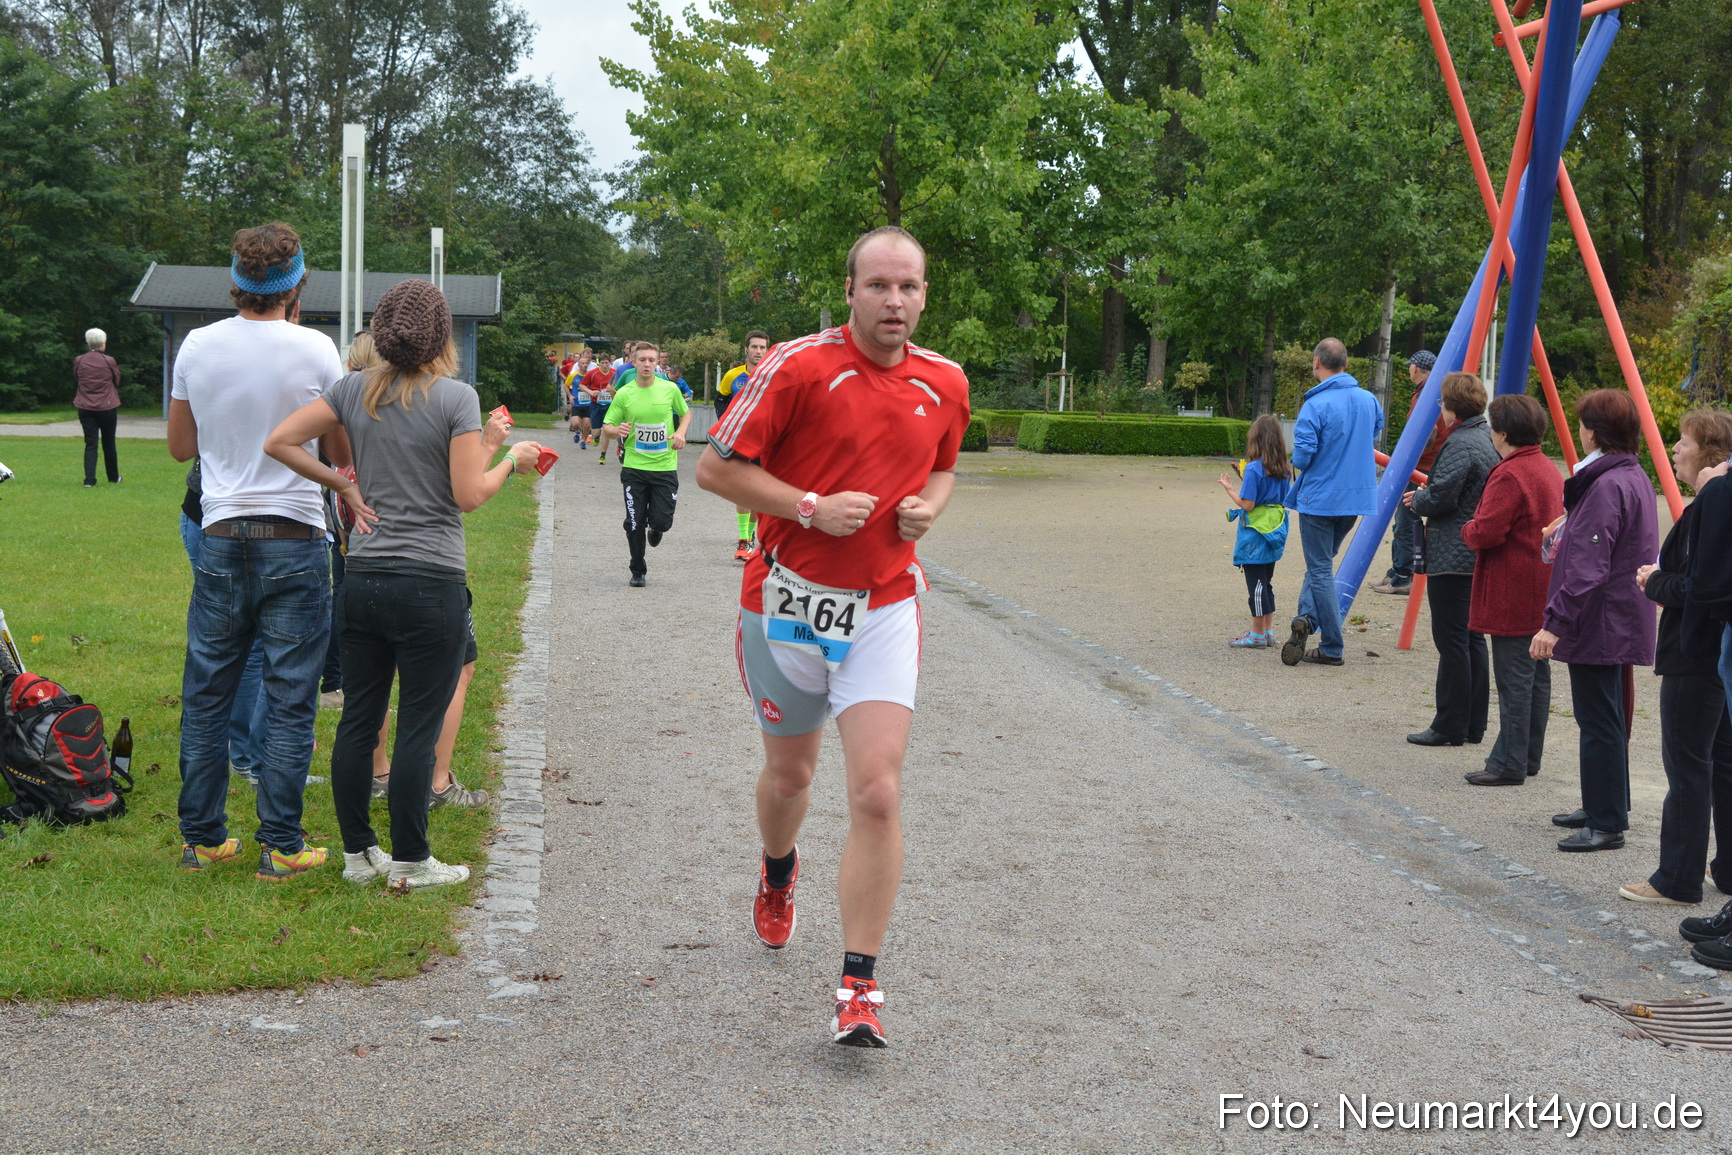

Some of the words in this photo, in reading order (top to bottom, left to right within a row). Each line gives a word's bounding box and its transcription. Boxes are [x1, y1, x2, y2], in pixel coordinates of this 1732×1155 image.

[638, 430, 665, 442] 2708
[230, 524, 275, 538] PMA
[778, 587, 855, 636] 2164
